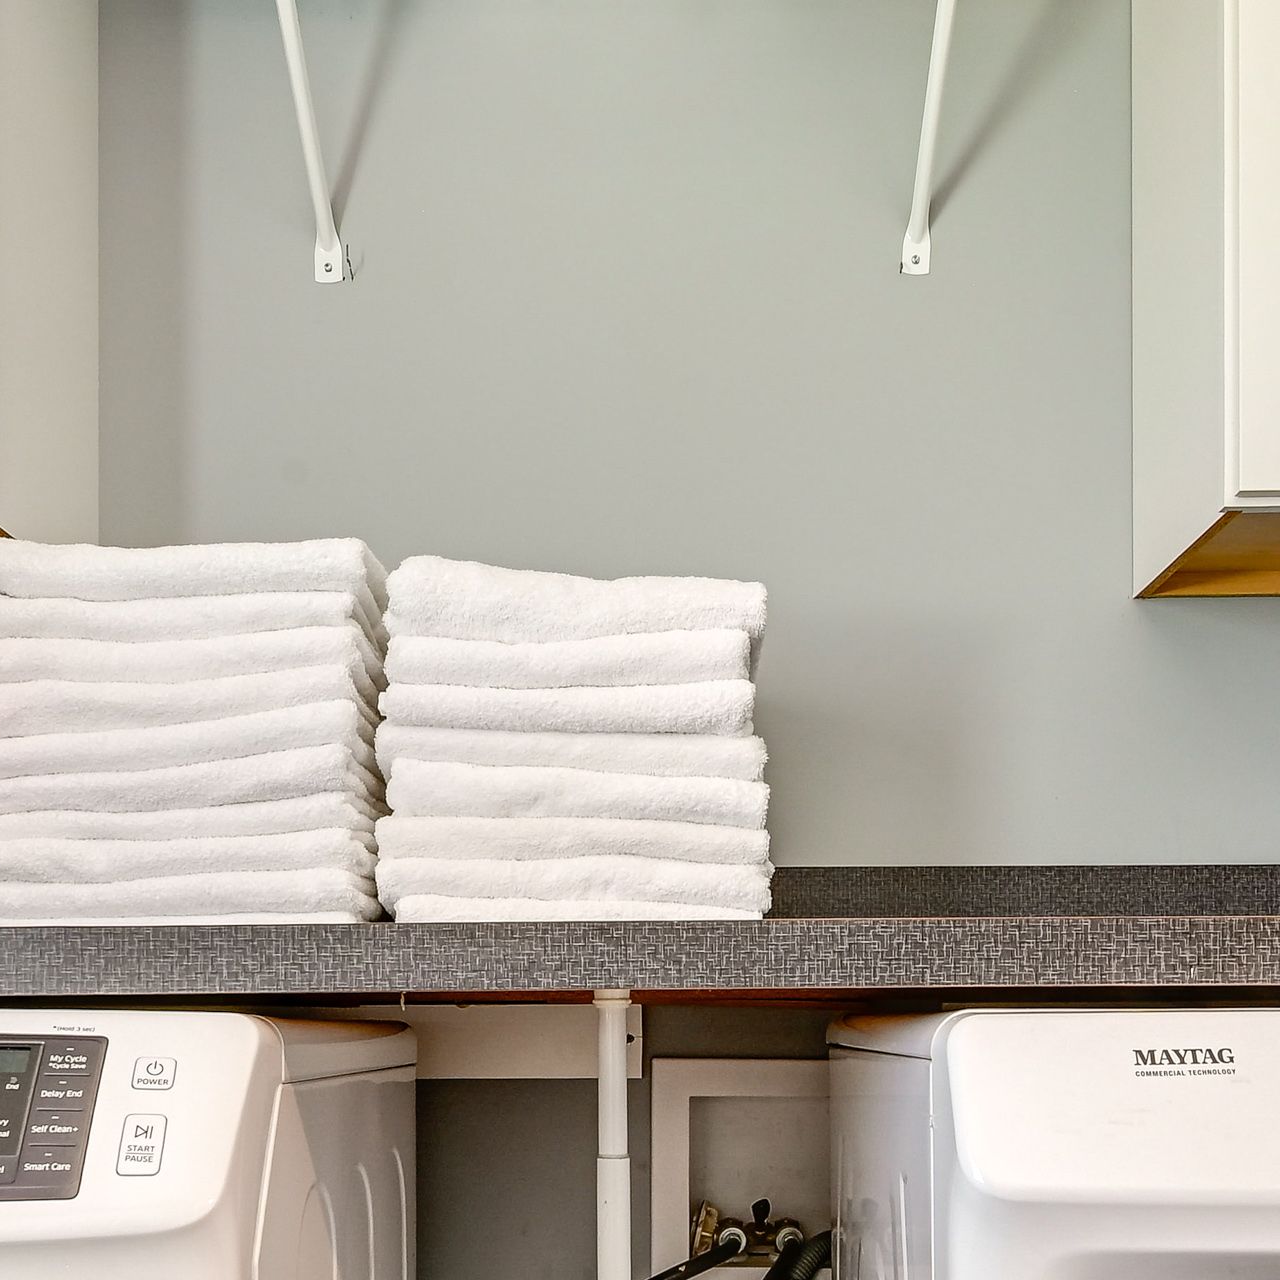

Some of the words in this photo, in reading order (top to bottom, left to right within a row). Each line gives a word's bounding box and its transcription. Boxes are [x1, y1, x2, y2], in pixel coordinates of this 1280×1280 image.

[50, 1055, 64, 1063] My
[64, 1055, 87, 1063] Cycle
[1132, 1048, 1234, 1066] MAYTAG
[40, 1090, 65, 1098] Delay
[31, 1125, 48, 1133] Self
[49, 1125, 79, 1133] Clean+
[24, 1163, 50, 1171] Smart
[51, 1163, 71, 1171] Care
